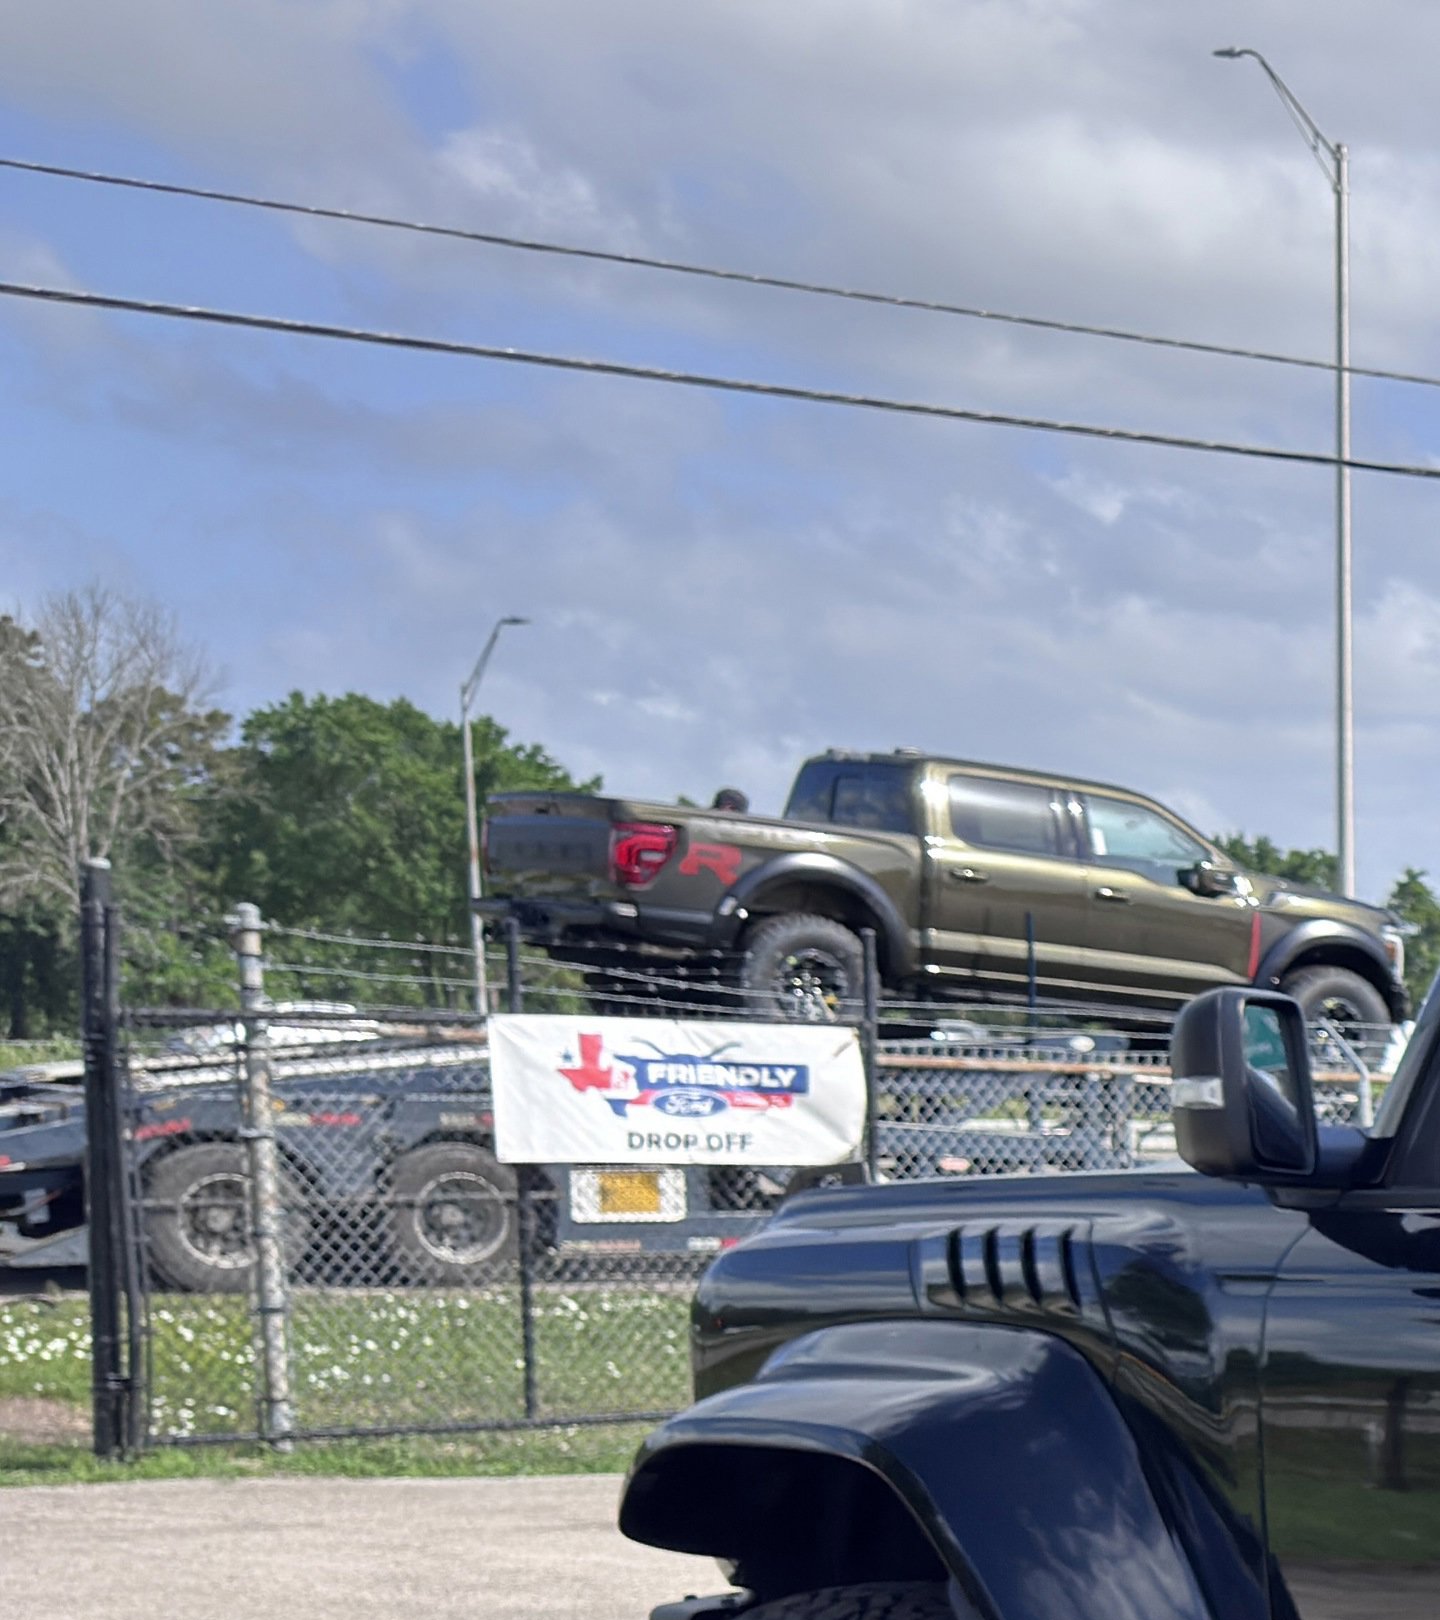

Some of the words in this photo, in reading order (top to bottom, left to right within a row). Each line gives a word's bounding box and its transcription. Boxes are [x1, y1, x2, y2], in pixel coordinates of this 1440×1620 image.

[647, 1062, 798, 1088] FRIENDLY
[664, 1093, 715, 1116] Ford
[627, 1131, 699, 1151] DROP
[706, 1133, 754, 1153] OFF
